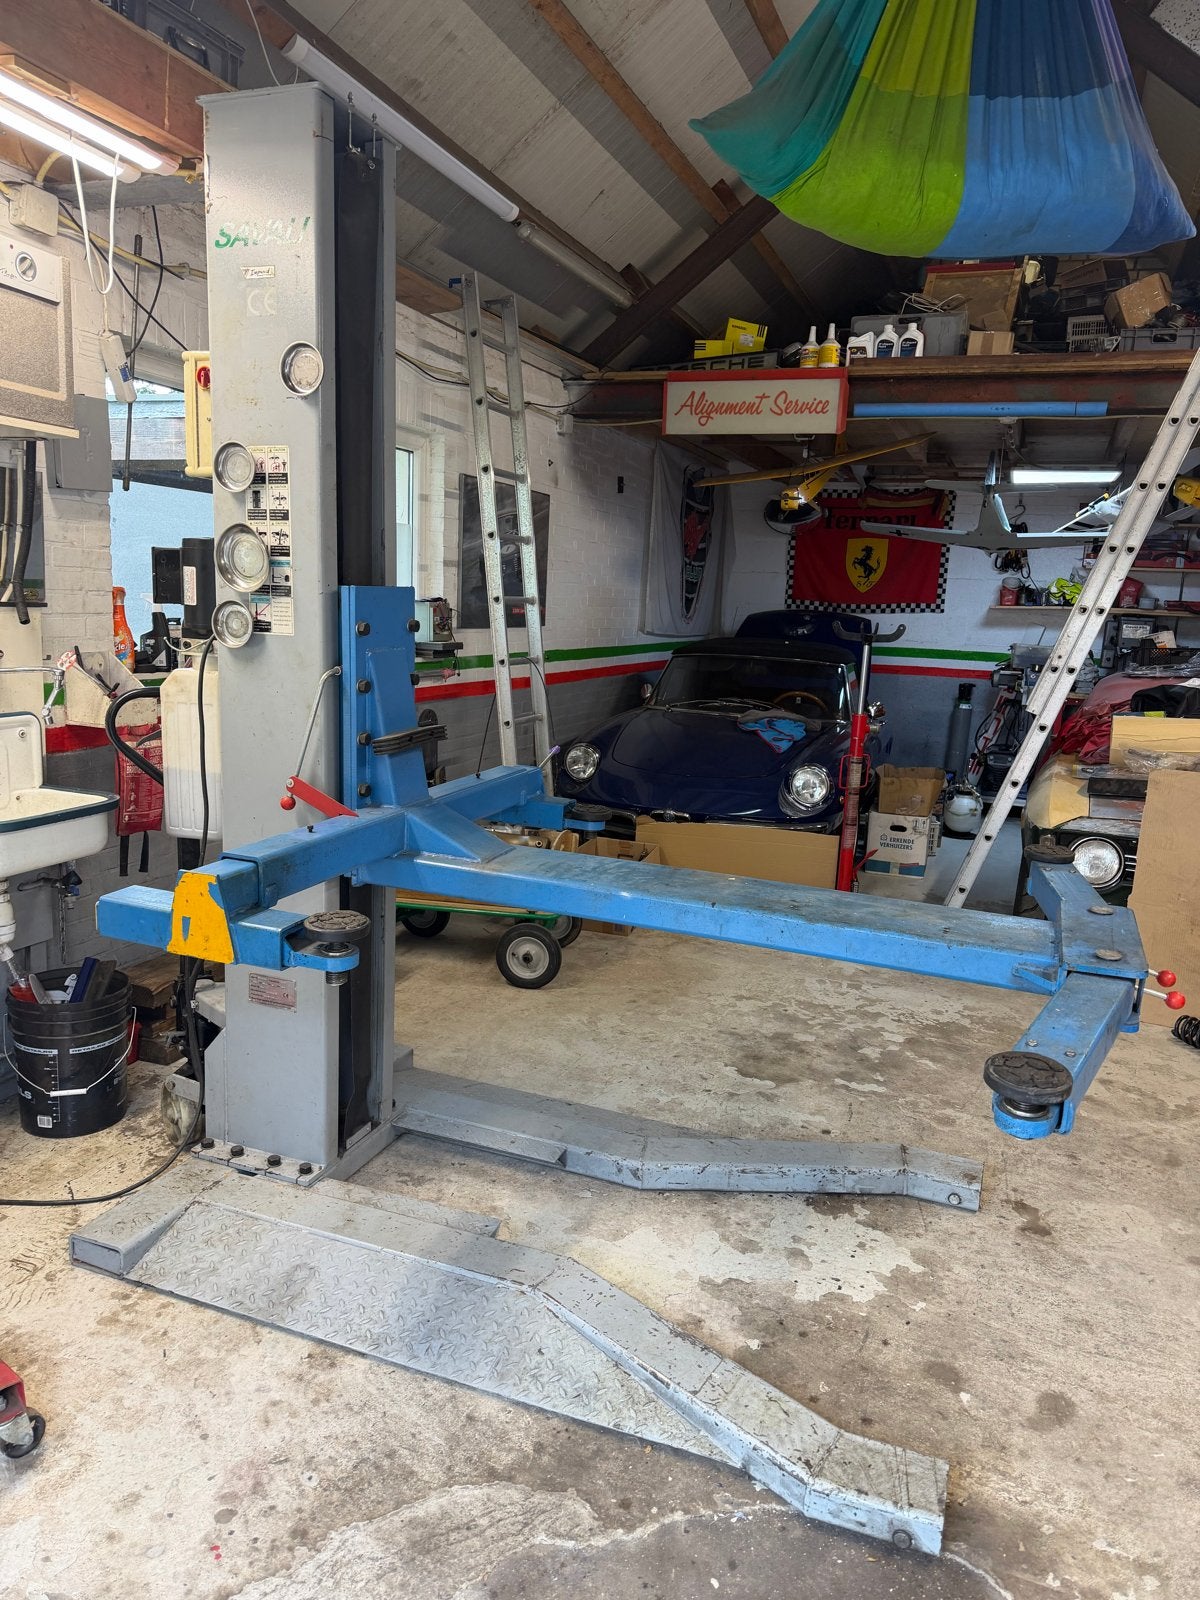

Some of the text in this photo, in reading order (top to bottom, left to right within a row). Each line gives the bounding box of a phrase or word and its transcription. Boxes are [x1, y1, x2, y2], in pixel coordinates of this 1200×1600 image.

[674, 390, 830, 427] Alignment Service
[880, 842, 913, 850] VERHUIZERS
